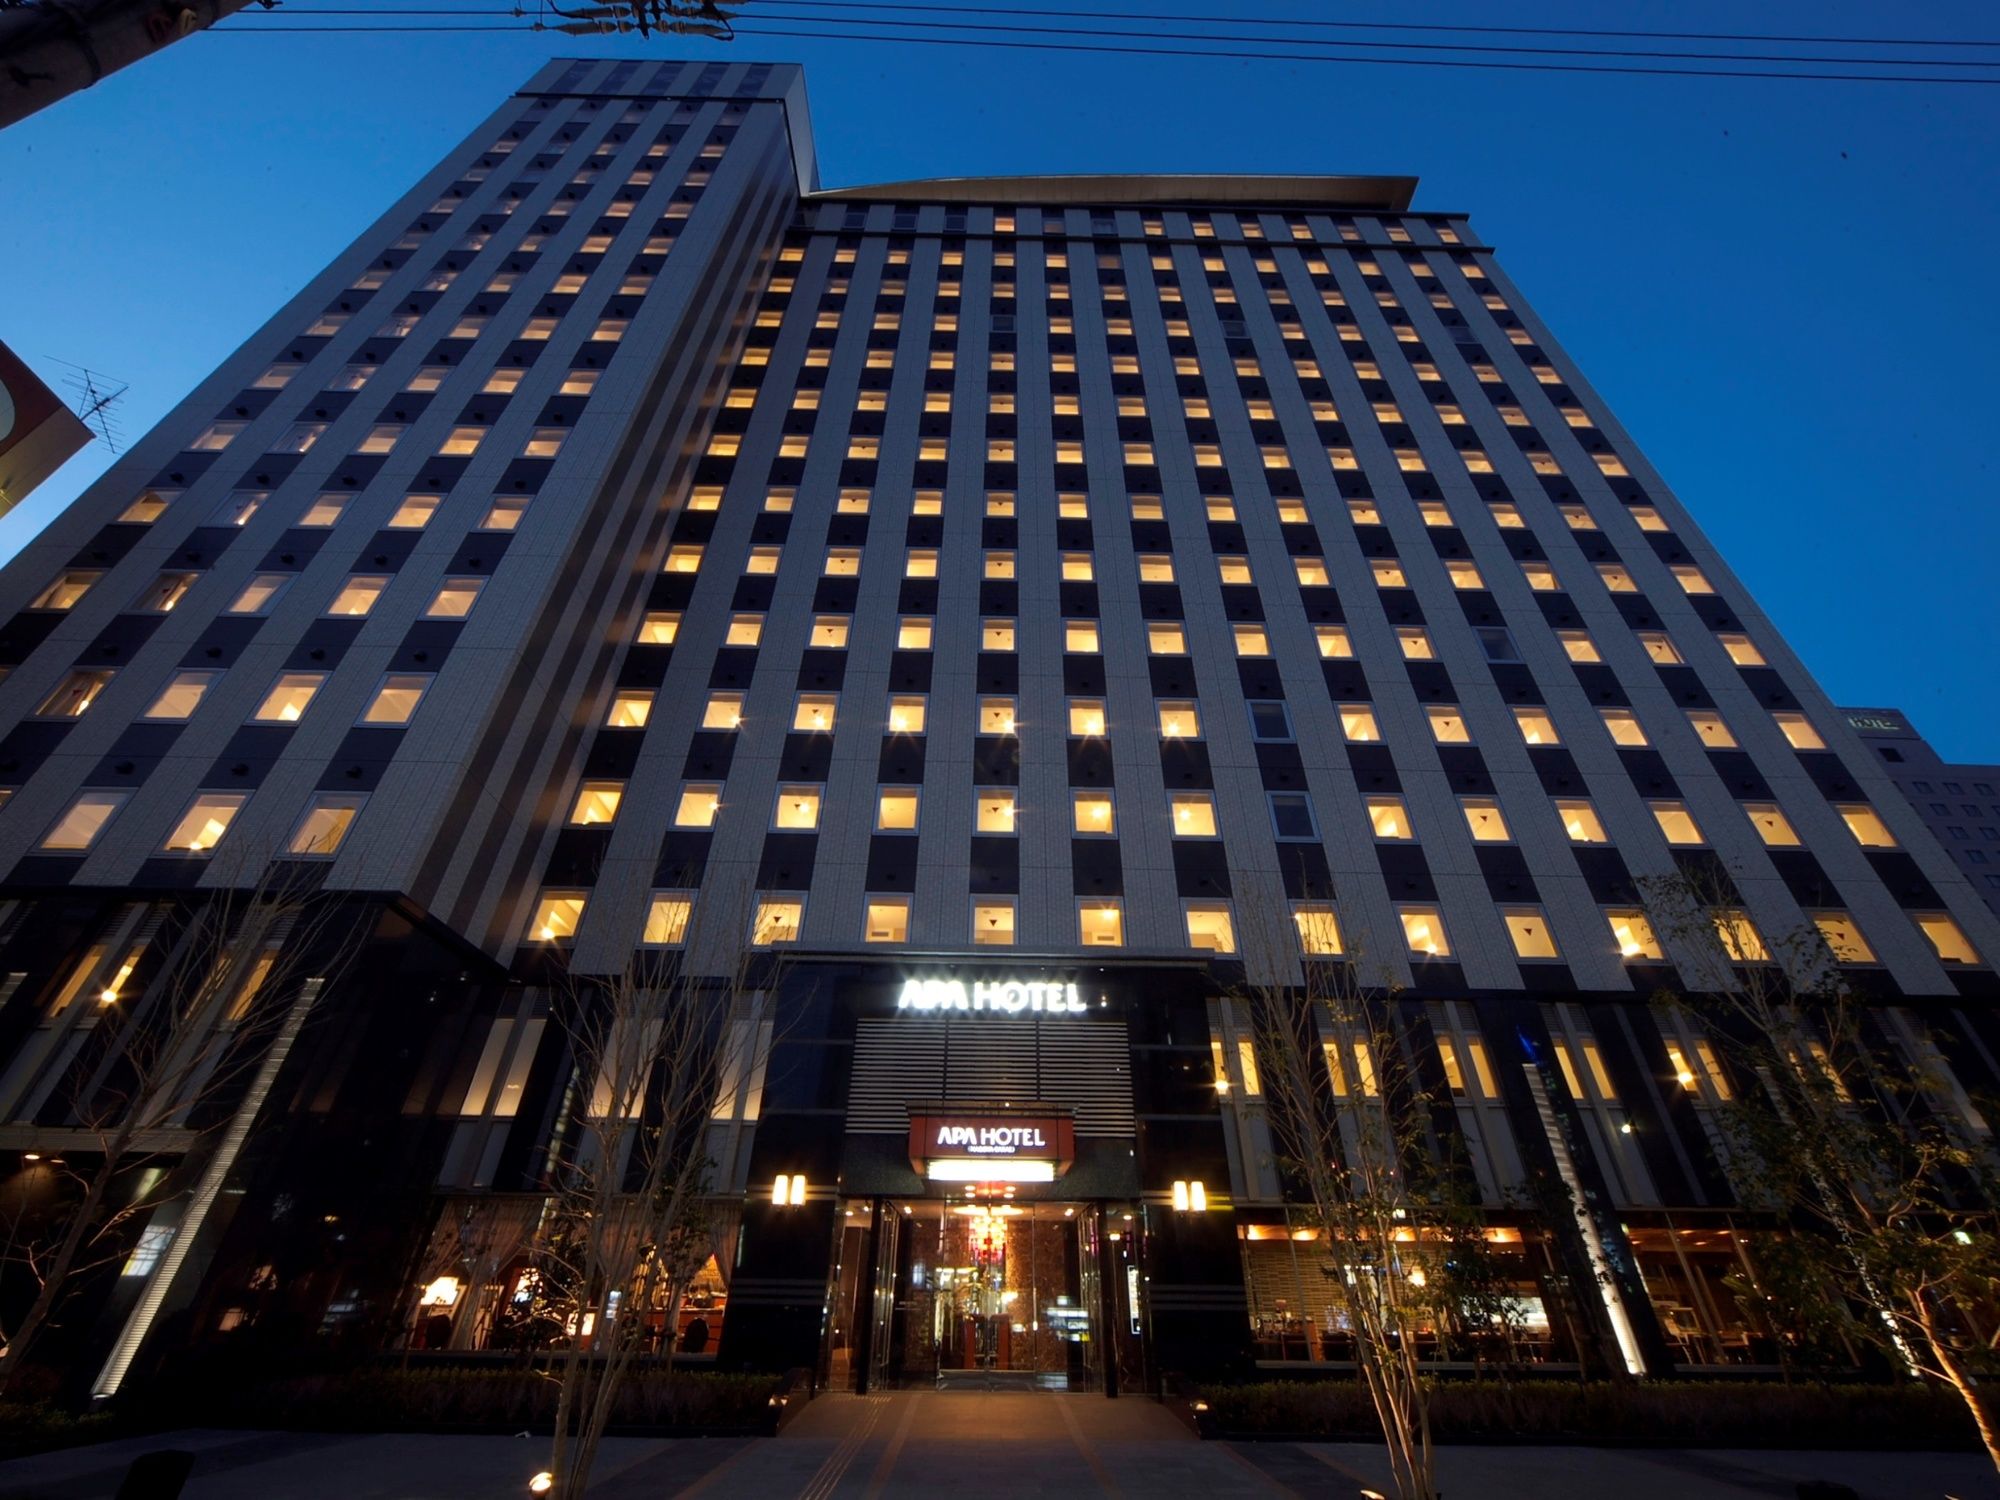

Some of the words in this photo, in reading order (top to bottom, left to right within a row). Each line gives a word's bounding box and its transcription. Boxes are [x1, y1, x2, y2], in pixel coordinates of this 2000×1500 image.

[898, 979, 969, 1010] APA
[973, 982, 1087, 1013] HOTEL
[937, 1126, 977, 1145] APA
[980, 1127, 1046, 1147] HOTEL
